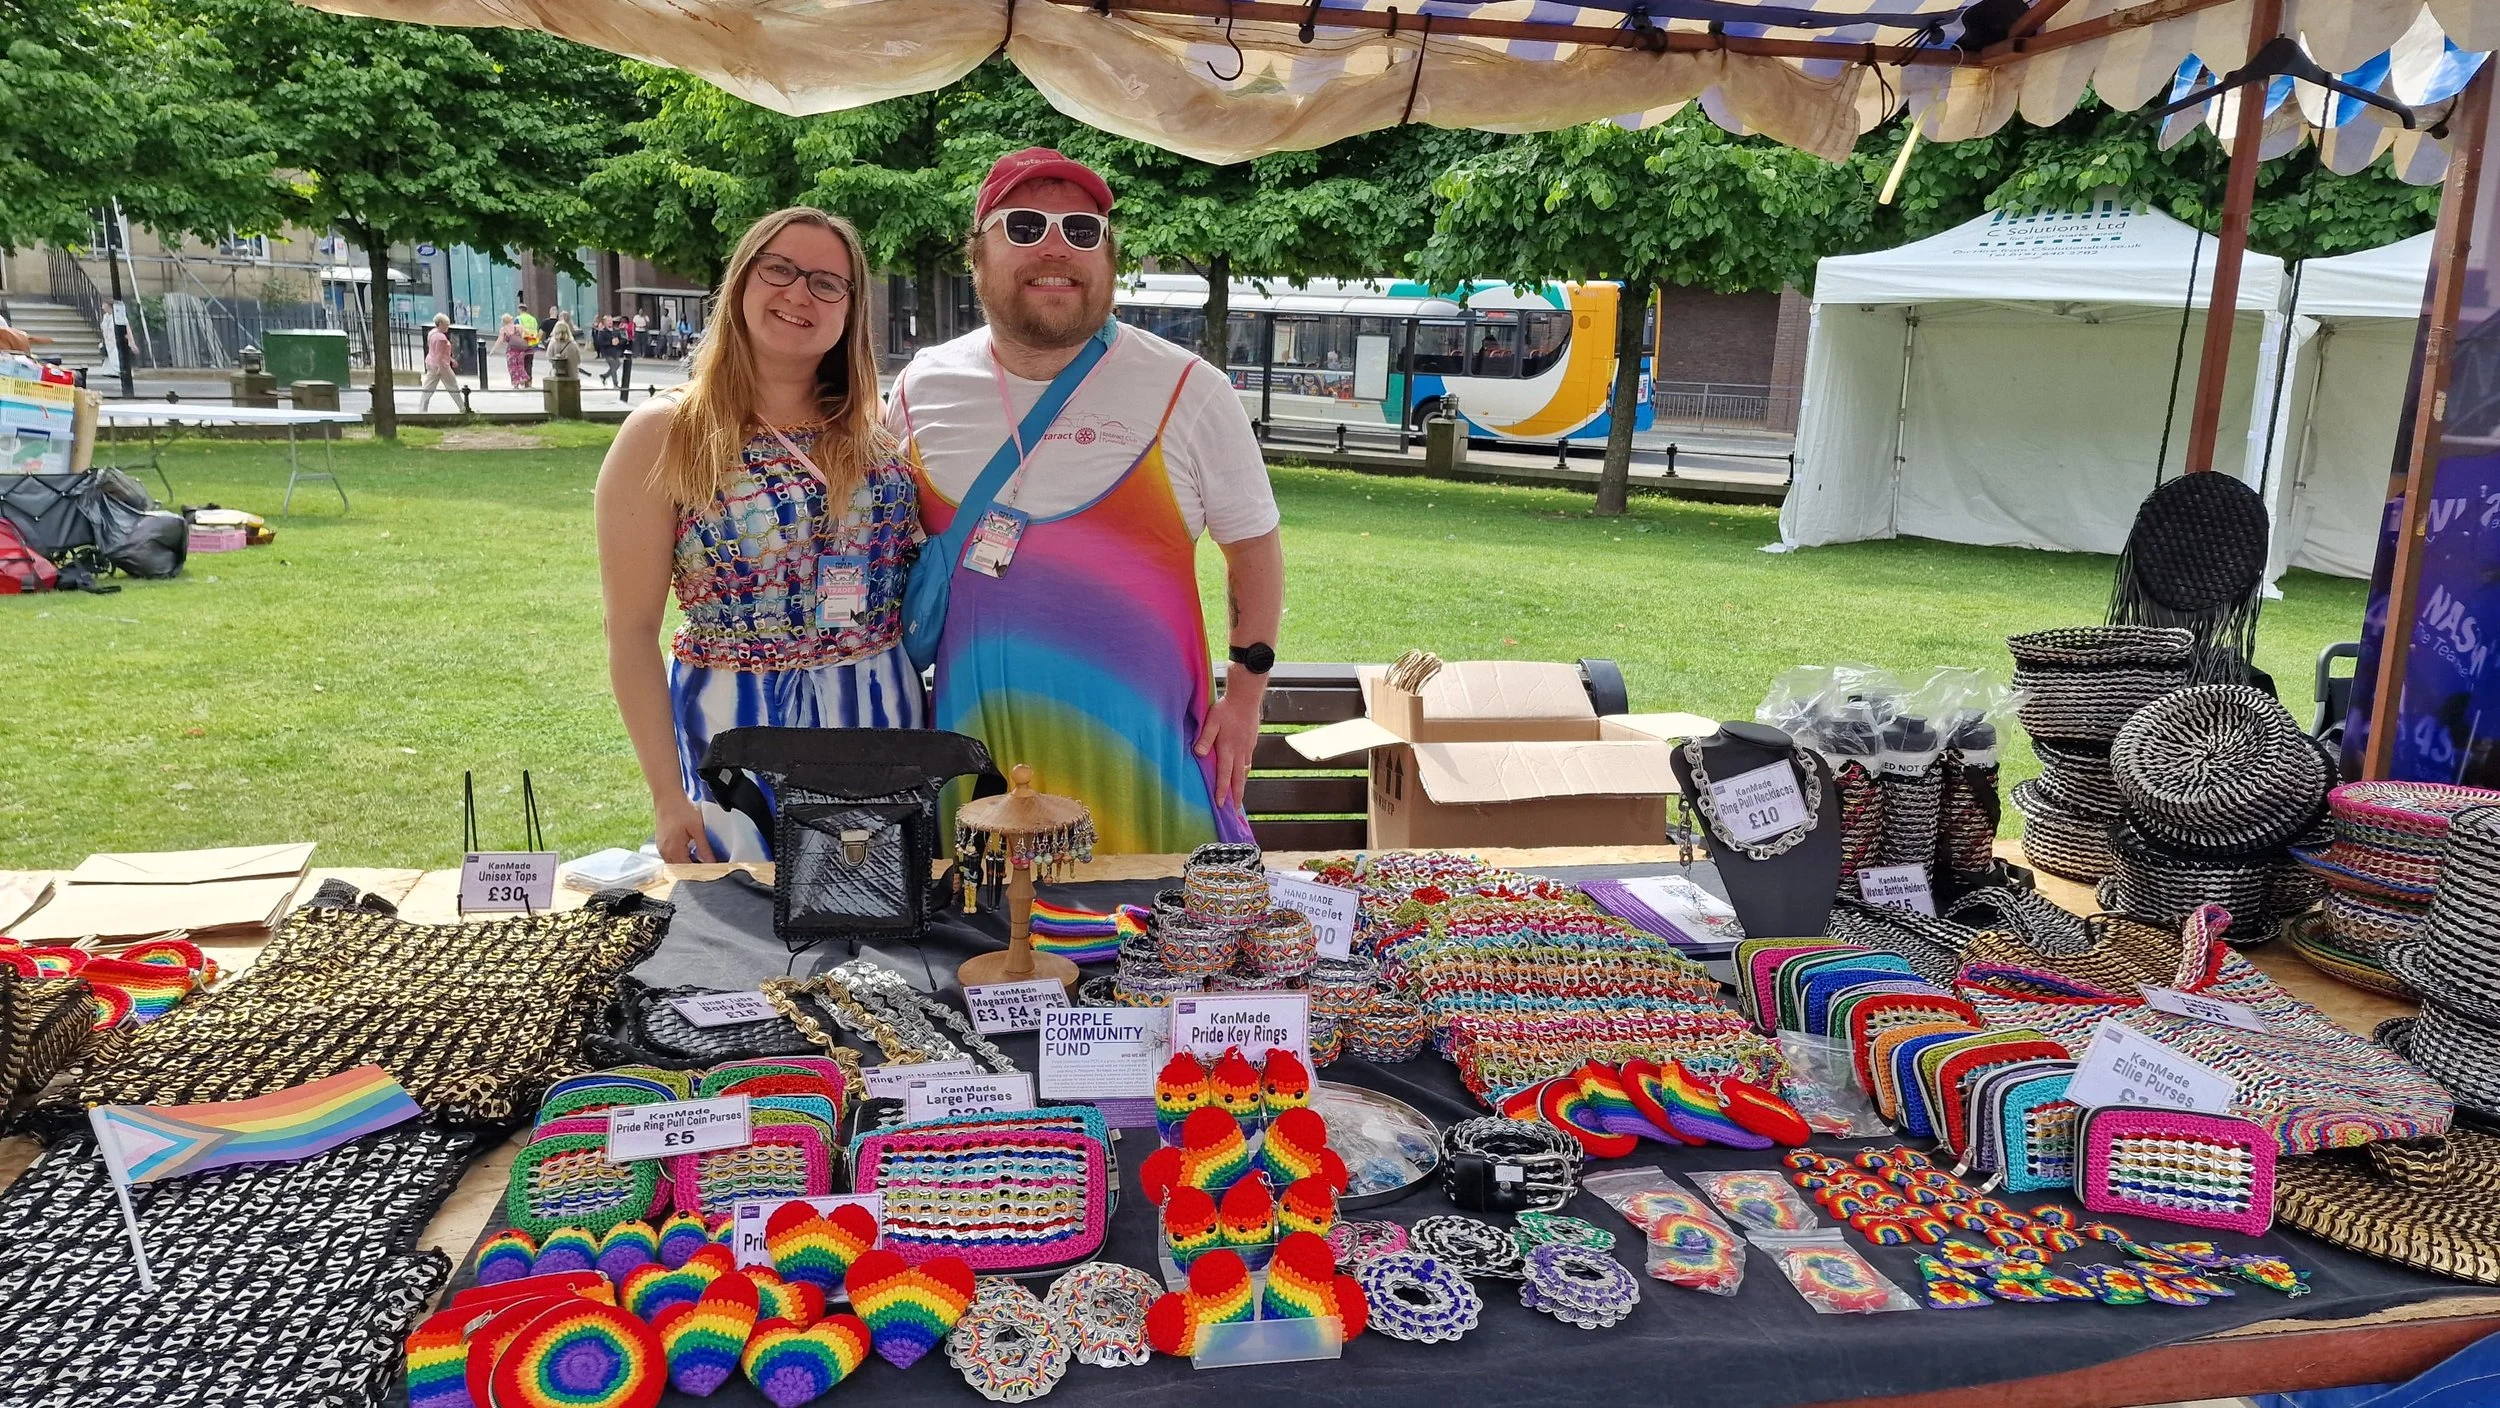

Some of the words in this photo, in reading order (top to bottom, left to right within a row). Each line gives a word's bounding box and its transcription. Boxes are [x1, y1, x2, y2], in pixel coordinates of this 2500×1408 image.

[1986, 229, 2001, 238] C
[2006, 225, 2089, 237] Solutions
[2096, 221, 2127, 231] Ltd
[1898, 764, 1920, 773] NOT
[1734, 779, 1773, 798] KanMade
[1720, 801, 1740, 816] Ring
[1738, 795, 1755, 811] Pull
[1754, 784, 1795, 804] Necklaces
[1748, 806, 1780, 830] £10
[488, 861, 532, 870] KanMade
[478, 870, 513, 882] Unisex
[514, 870, 538, 884] Tops
[487, 886, 525, 902] £30
[1284, 887, 1308, 900] HAND
[1308, 892, 1335, 906] MADE
[1865, 887, 1885, 898] Water
[1884, 884, 1904, 896] Bottle
[1903, 882, 1928, 894] Holders
[1271, 895, 1295, 910] Cuff
[1296, 901, 1344, 921] Bracelet
[992, 987, 1038, 997] KanMade
[696, 999, 727, 1008] Inner
[728, 996, 754, 1005] Tube
[702, 1003, 736, 1014] Body
[738, 1001, 764, 1010] Bag
[971, 995, 1021, 1009] Magazine
[1021, 992, 1064, 1004] Earrings
[725, 1008, 759, 1020] £15
[976, 1007, 1006, 1023] £3,
[1007, 1005, 1030, 1020] £4
[1046, 1012, 1114, 1027] PURPLE
[1210, 1011, 1271, 1025] KanMade
[1010, 1020, 1020, 1029] A
[1020, 1018, 1041, 1028] Pair
[1045, 1026, 1144, 1042] COMMUNITY
[1192, 1026, 1224, 1044] Pride
[1227, 1025, 1251, 1047] Key
[1254, 1024, 1288, 1046] Rings
[1045, 1042, 1091, 1057] FUND
[2129, 1051, 2191, 1089] KanMade
[869, 1076, 894, 1085] Ring
[2112, 1056, 2144, 1084] Ellie
[2144, 1072, 2196, 1109] Purses
[940, 1084, 997, 1095] KanMade
[926, 1093, 960, 1106] Large
[966, 1091, 1013, 1103] Purses
[616, 1121, 642, 1134] Pride
[643, 1120, 665, 1132] Ring
[667, 1117, 685, 1129] Pull
[686, 1115, 708, 1127] Coin
[709, 1111, 743, 1123] Purses
[649, 1108, 711, 1121] KanMade
[664, 1130, 696, 1147] £5
[743, 1231, 768, 1252] Pri
